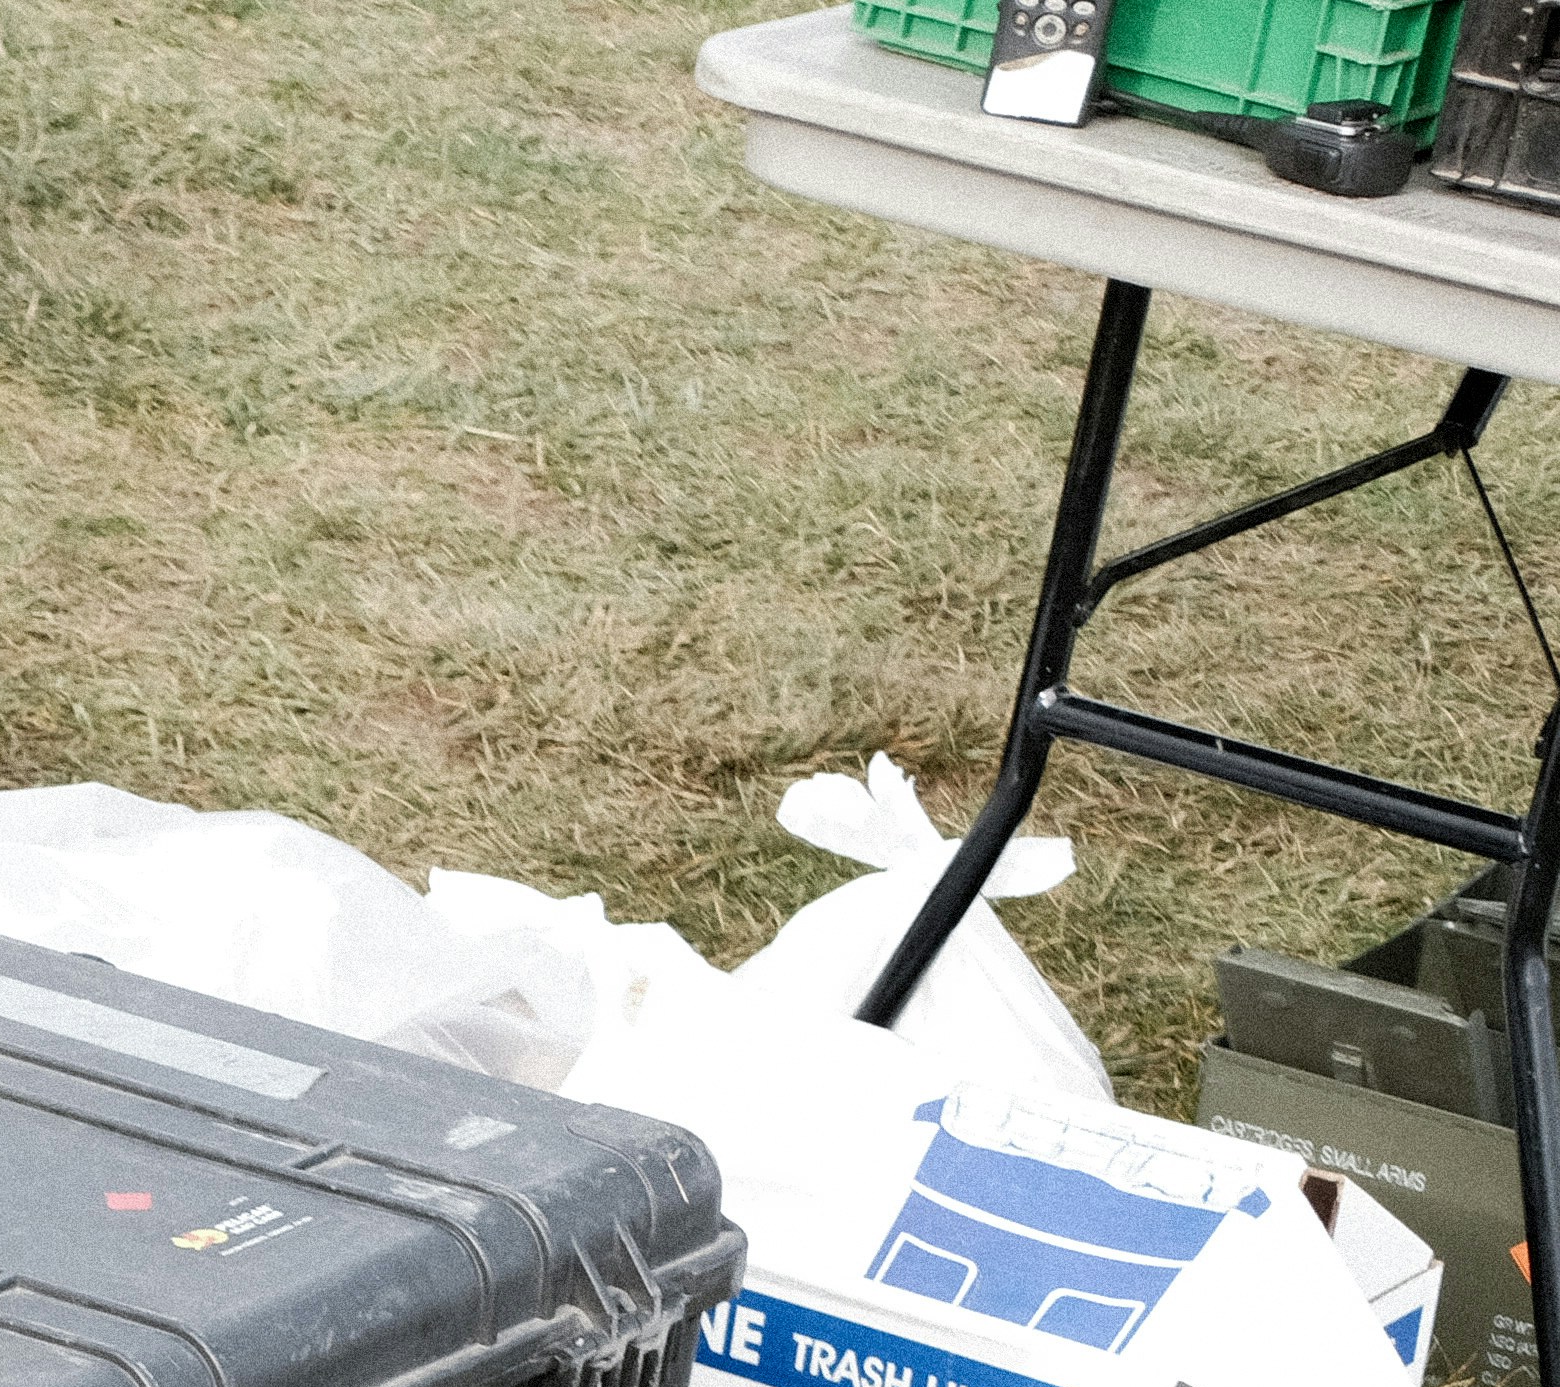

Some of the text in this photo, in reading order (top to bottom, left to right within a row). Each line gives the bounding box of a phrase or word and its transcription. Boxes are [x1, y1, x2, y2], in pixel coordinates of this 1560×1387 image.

[1320, 1145, 1374, 1178] SMALL
[1376, 1162, 1428, 1192] ARMS
[699, 1300, 767, 1367] NE
